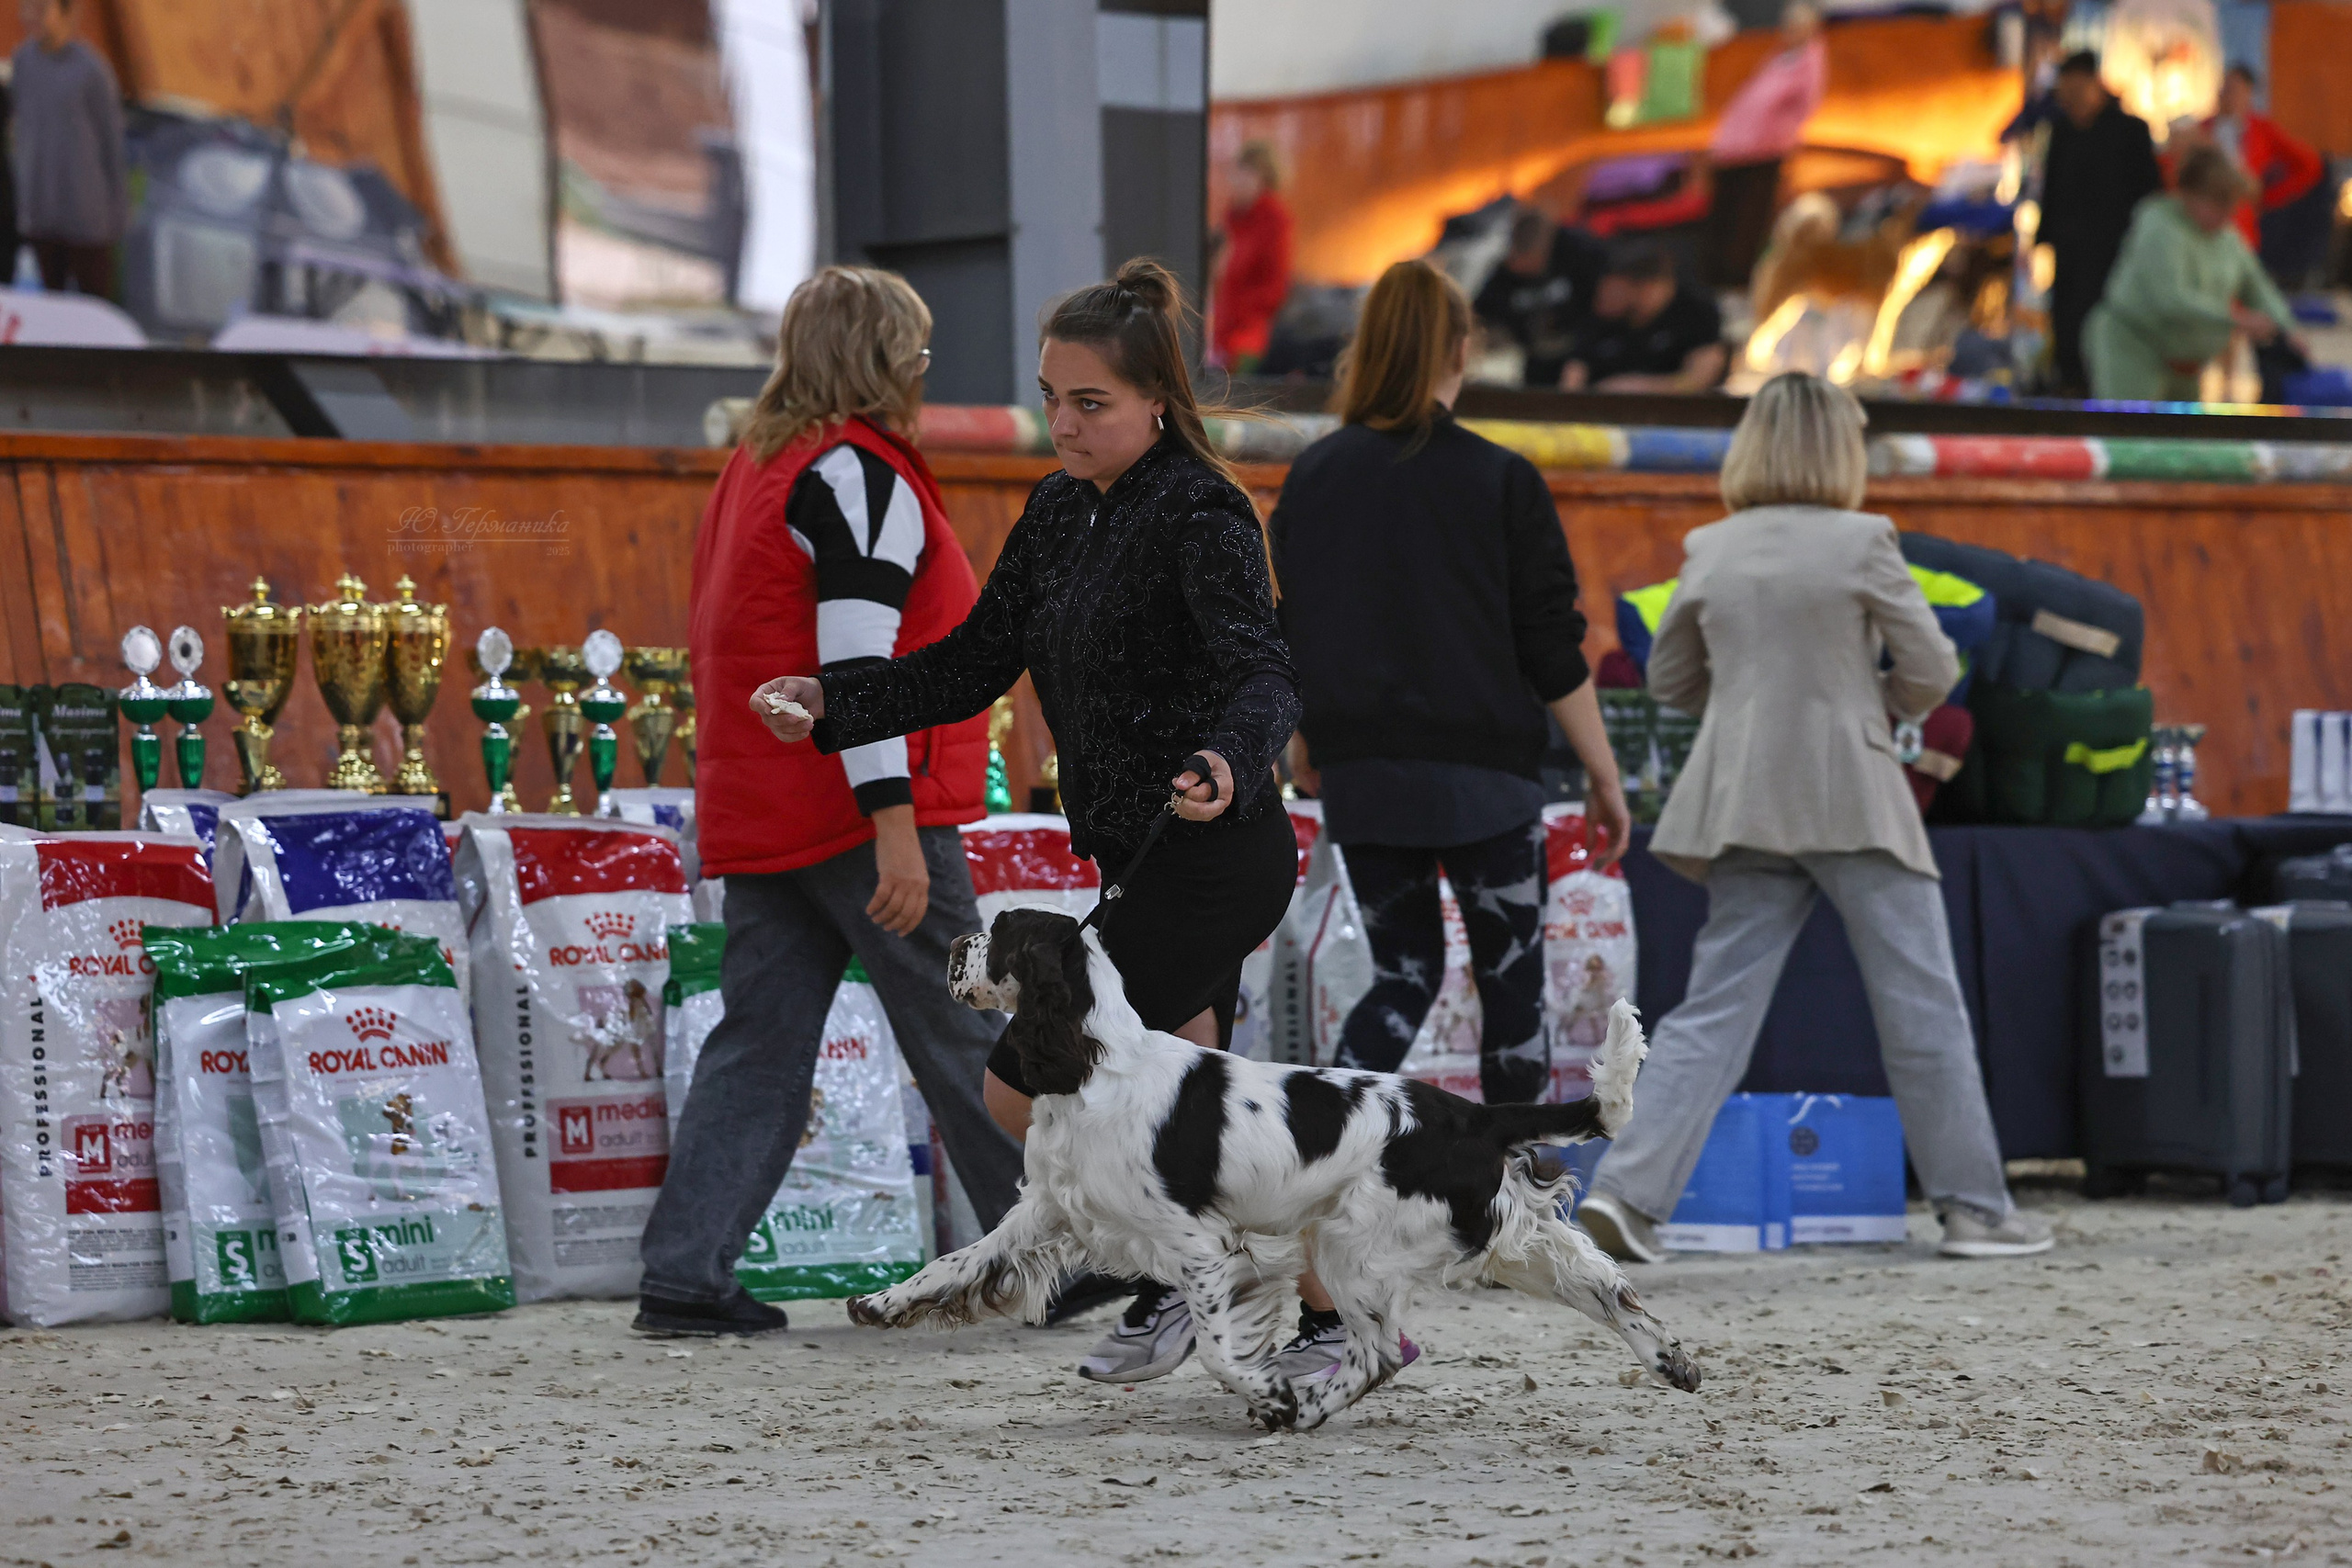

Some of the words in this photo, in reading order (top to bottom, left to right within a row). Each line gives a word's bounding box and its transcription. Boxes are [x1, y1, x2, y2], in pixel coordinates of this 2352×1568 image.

[69, 954, 136, 976] ROYAL
[200, 1049, 251, 1074] ROY
[309, 1046, 377, 1075] ROYAL
[380, 1041, 449, 1068] CANIN
[516, 985, 537, 1158] PROFESSIONAL
[30, 997, 53, 1177] PROFESSIONAL
[374, 1214, 435, 1247] mini
[381, 1253, 426, 1274] adult
